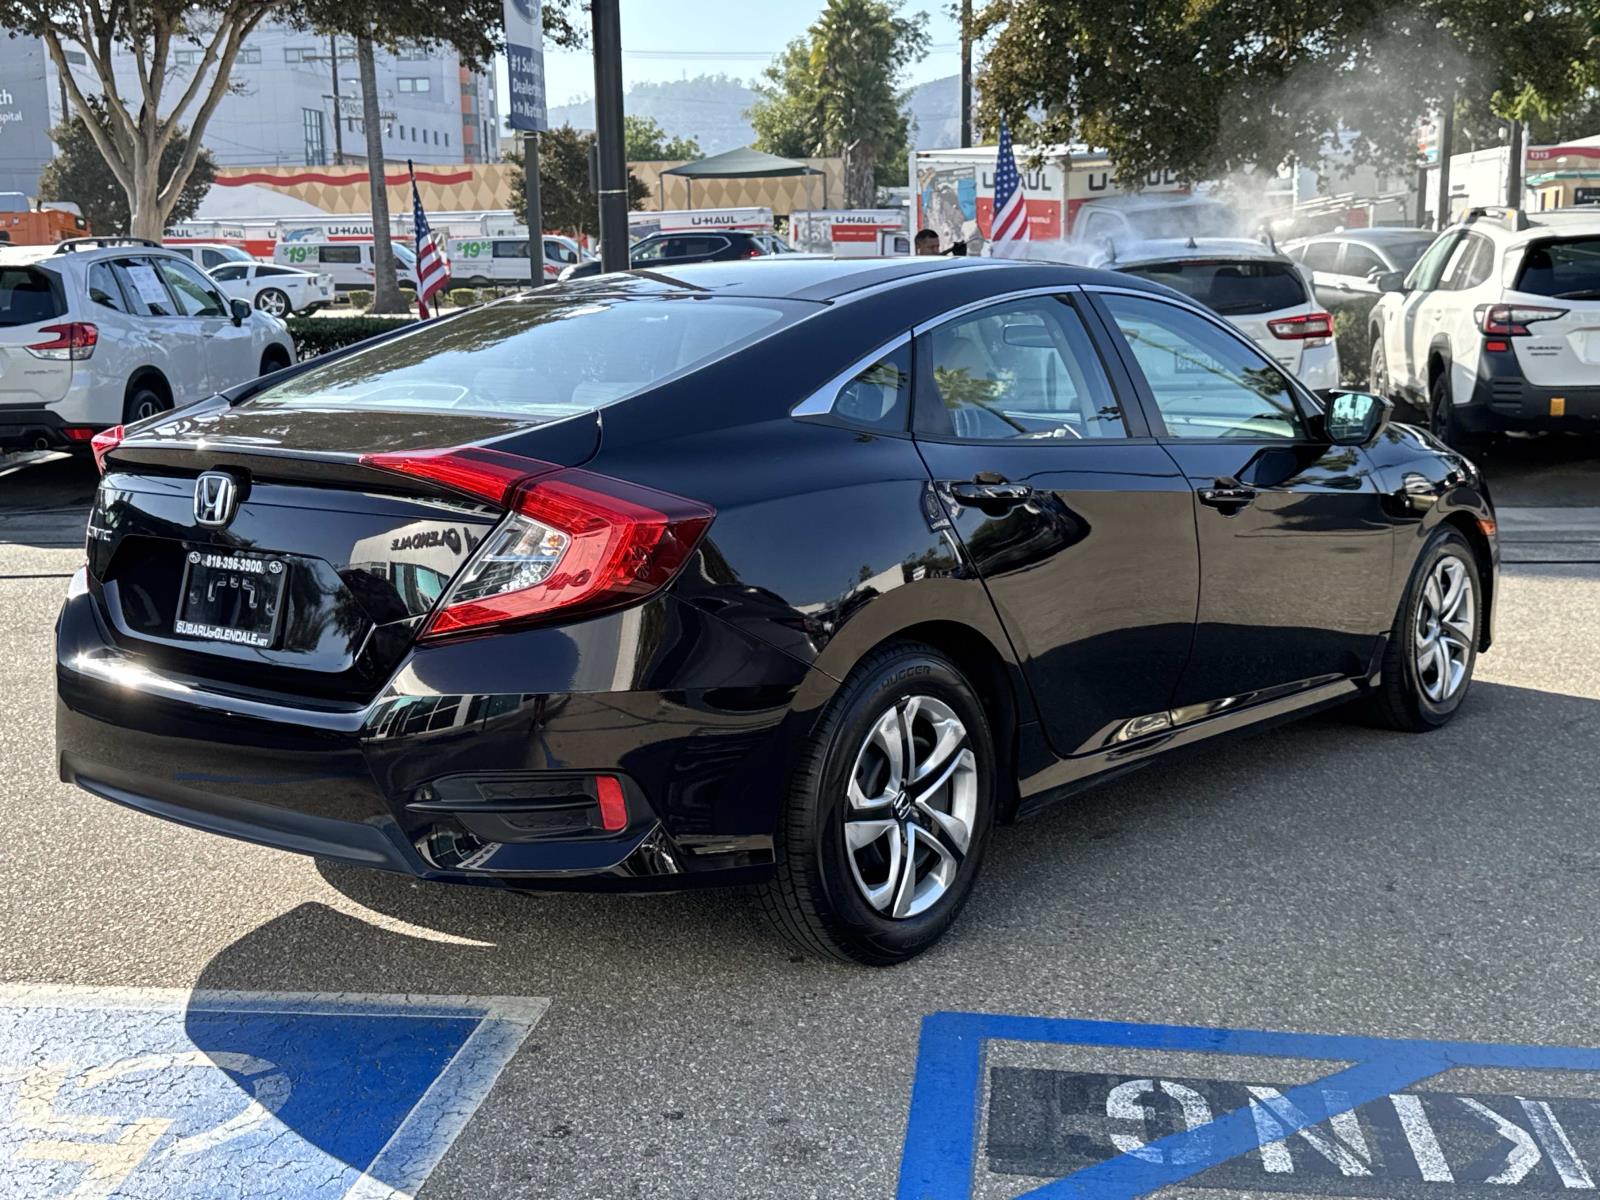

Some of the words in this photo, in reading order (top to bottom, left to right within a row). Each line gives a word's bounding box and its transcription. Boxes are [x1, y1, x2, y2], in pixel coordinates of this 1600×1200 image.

[691, 216, 737, 225] U-HAUL
[835, 216, 877, 224] U-HAUL
[206, 554, 262, 573] 818-396-3900
